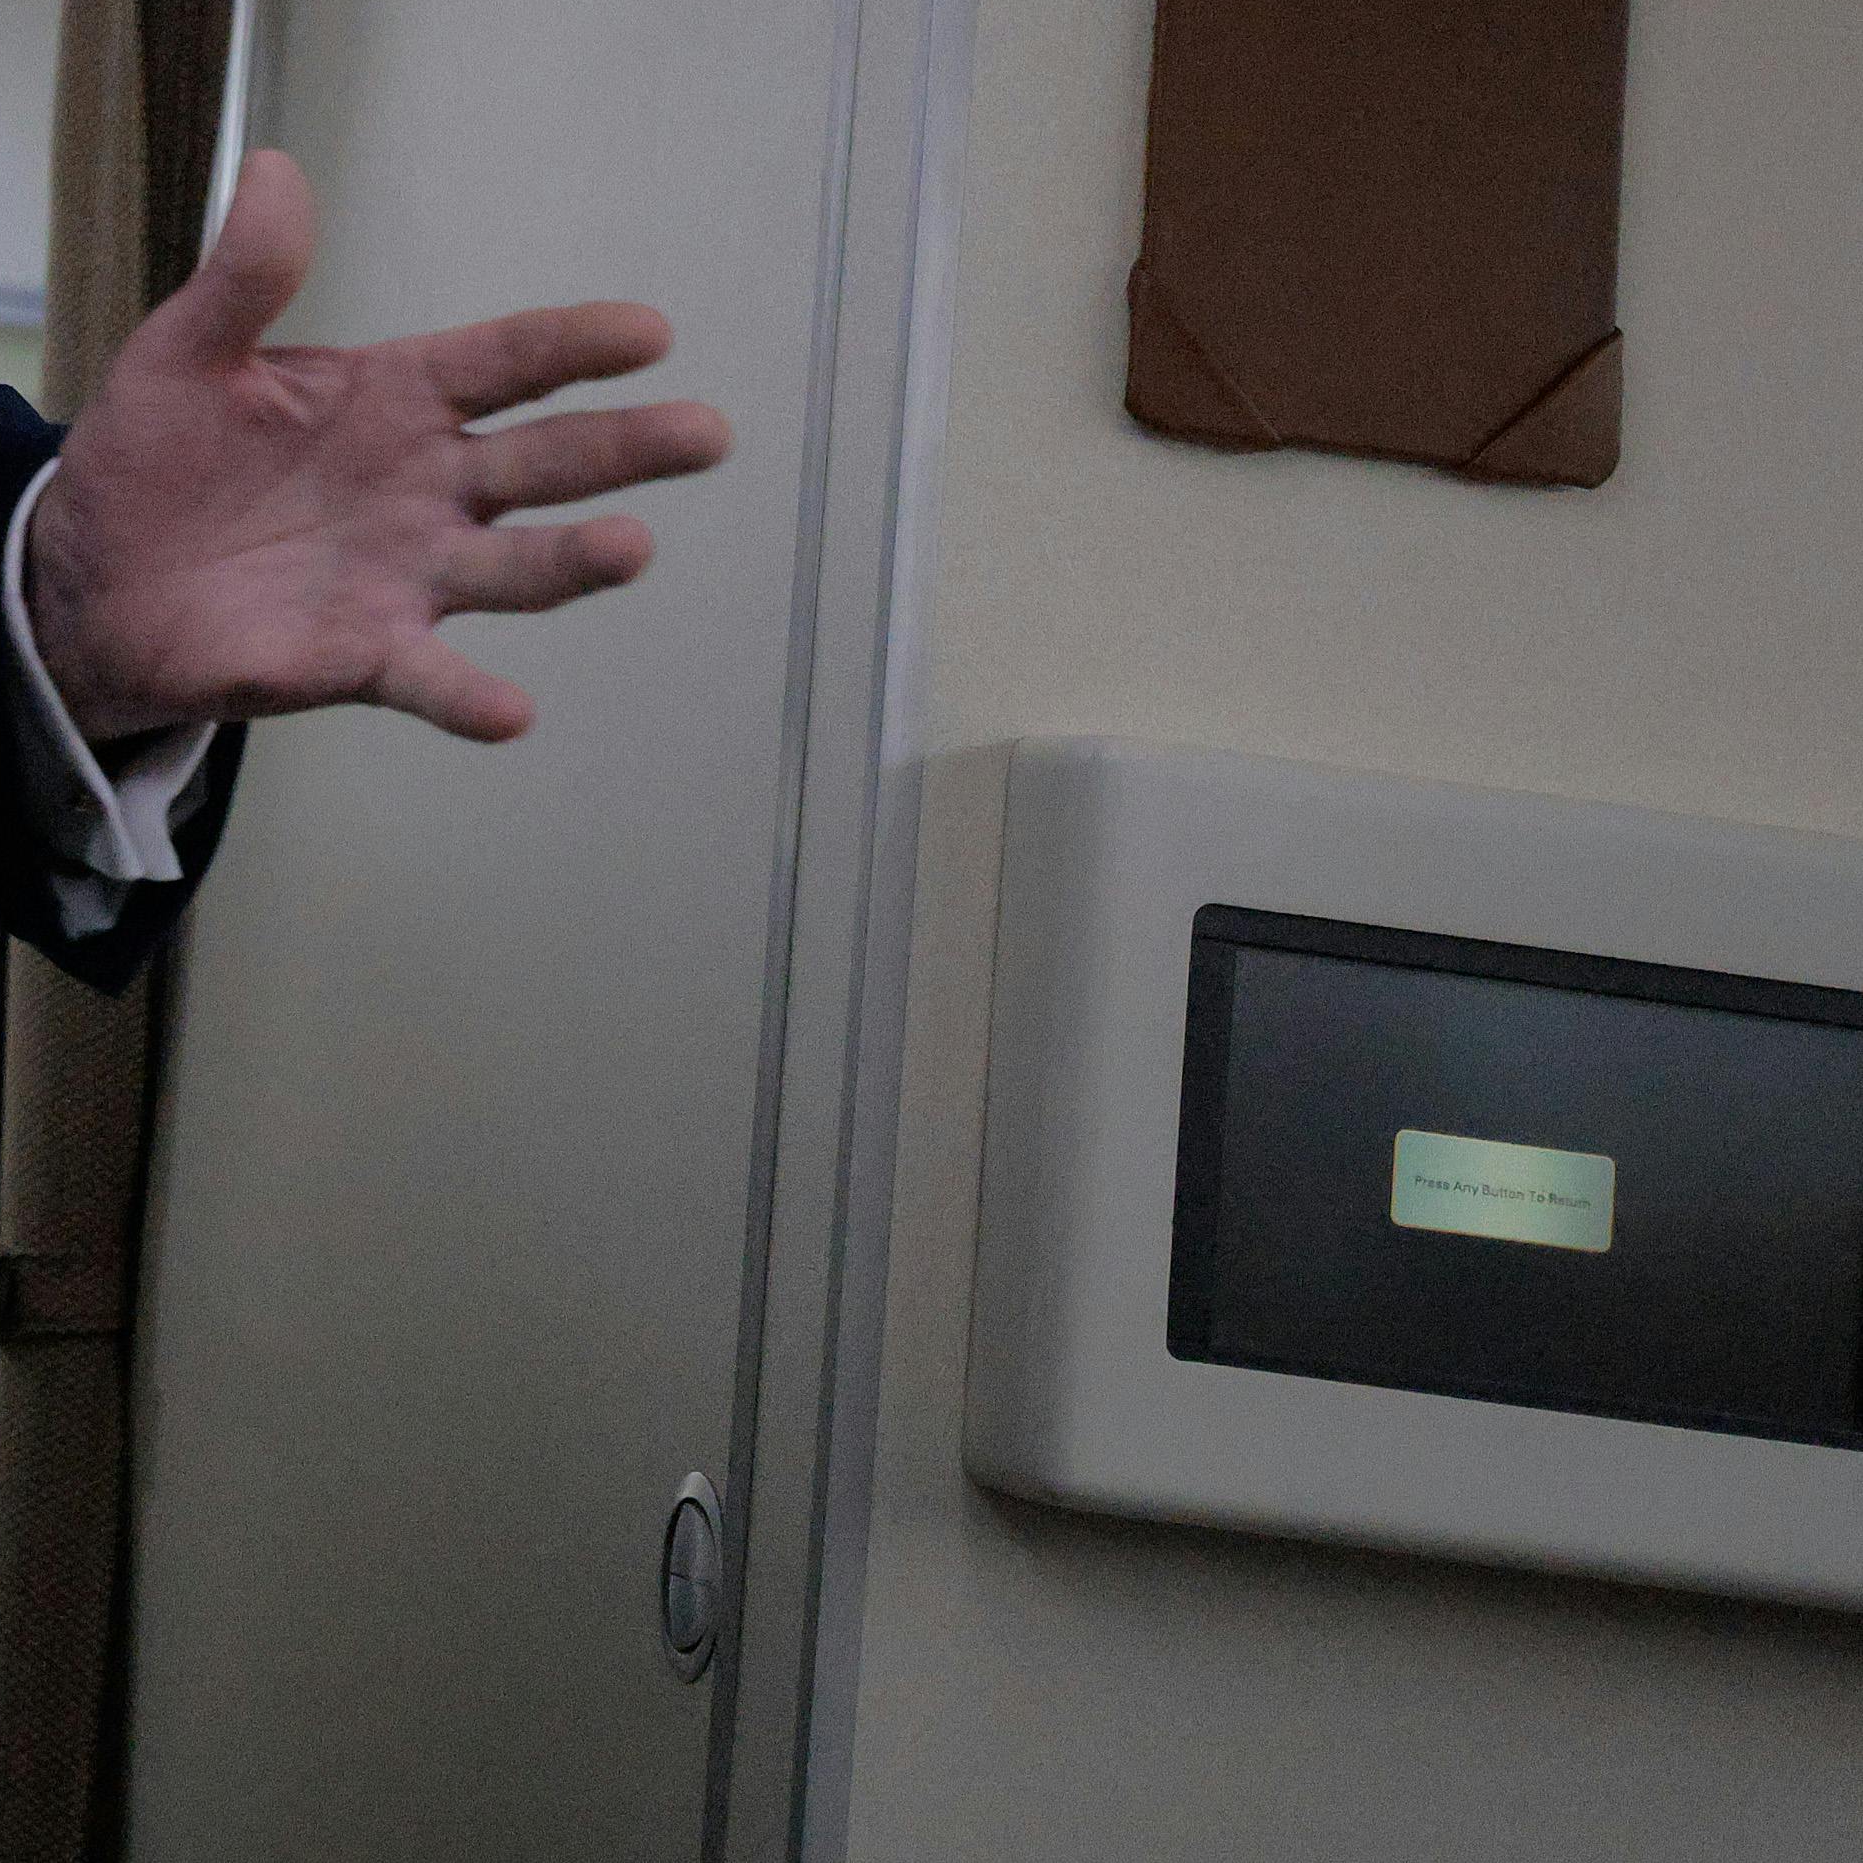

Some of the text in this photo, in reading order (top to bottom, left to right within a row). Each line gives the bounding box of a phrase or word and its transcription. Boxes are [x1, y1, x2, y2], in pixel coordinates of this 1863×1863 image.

[1414, 1175, 1450, 1191] Press
[1453, 1181, 1478, 1196] Any
[1482, 1185, 1524, 1200] Button
[1529, 1190, 1546, 1203] To
